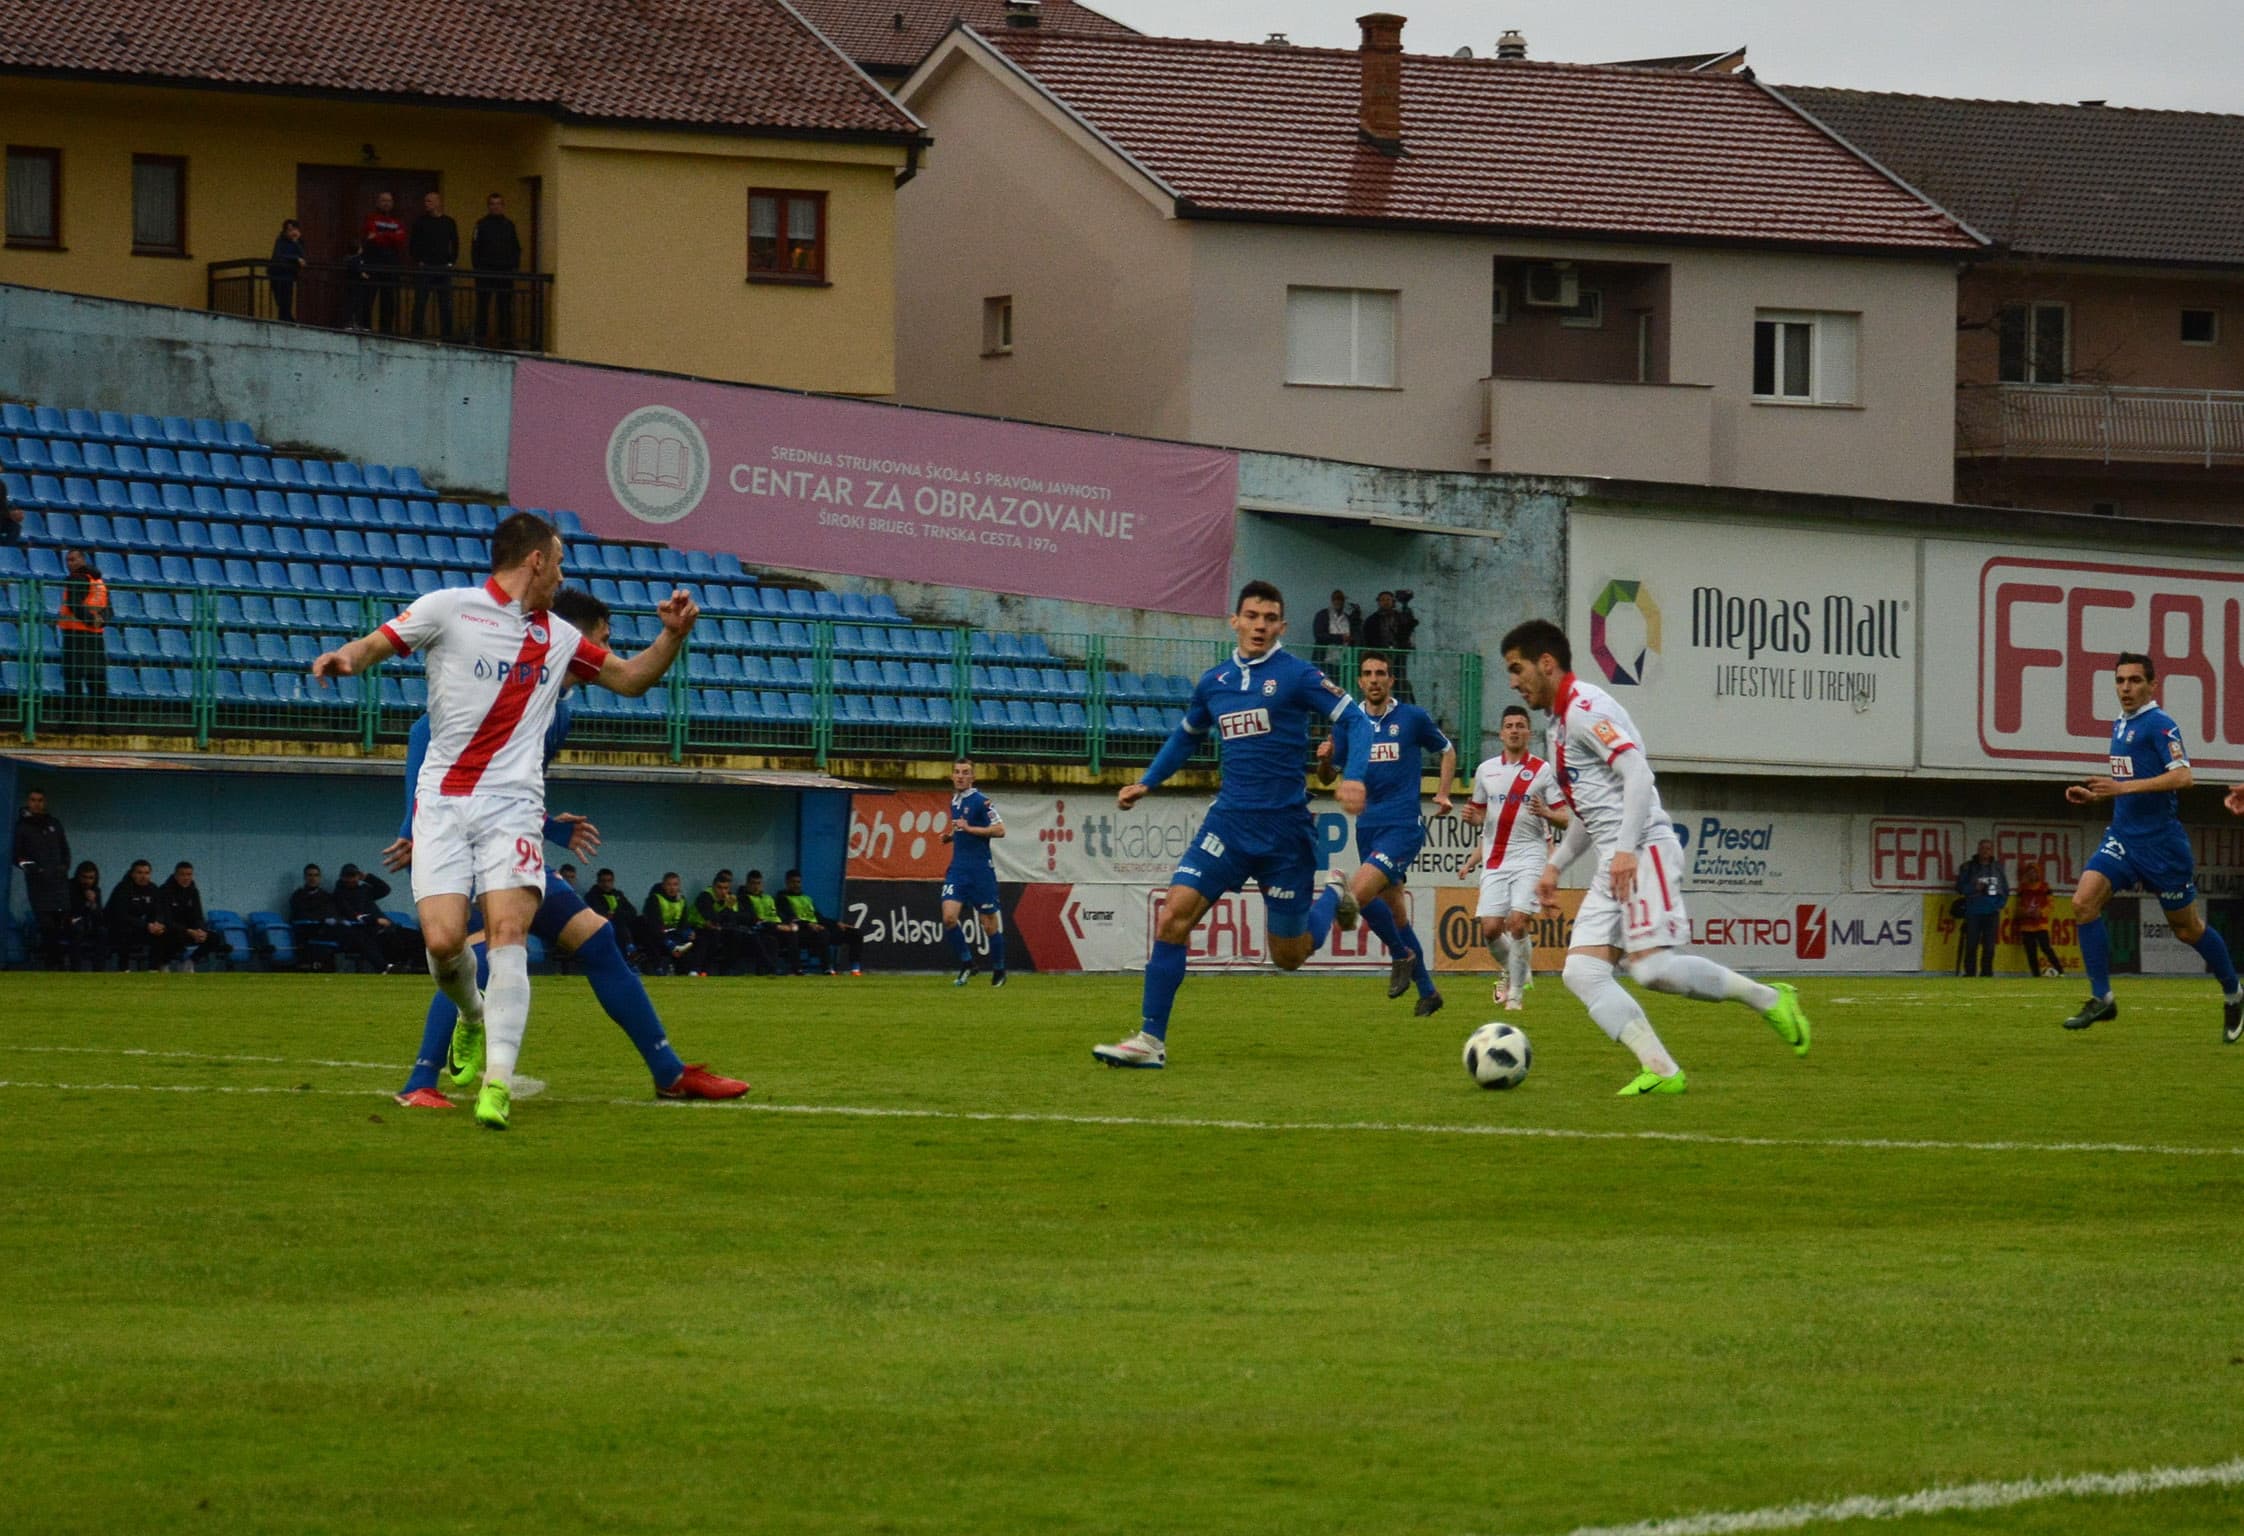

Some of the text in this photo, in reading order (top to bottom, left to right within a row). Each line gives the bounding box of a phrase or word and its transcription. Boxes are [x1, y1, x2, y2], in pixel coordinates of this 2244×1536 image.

[771, 446, 1111, 500] SREDNJA STRUKOVNA ŠKOLA S PRAVOM JAVNOSTI
[729, 464, 1135, 540] CENTAR ZA OBRAZOVANJE
[818, 507, 865, 529] ŠIROKI
[922, 524, 976, 543] TRNSKA
[980, 531, 1022, 549] CESTA
[1823, 595, 1901, 659] Mall
[1716, 664, 1796, 699] LIFESTYLE
[1803, 669, 1813, 700] U
[1221, 711, 1268, 737] FEAL
[1371, 745, 1397, 760] EAL
[2111, 757, 2131, 775] EAL
[1698, 817, 1773, 850] Presal
[1693, 849, 1767, 876] Extrusion
[1874, 827, 1959, 882] FEAL
[848, 903, 886, 943] Za
[890, 906, 943, 944] klasu
[1083, 908, 1115, 921] kramar
[1689, 918, 1913, 946] LEKTRO MILAS
